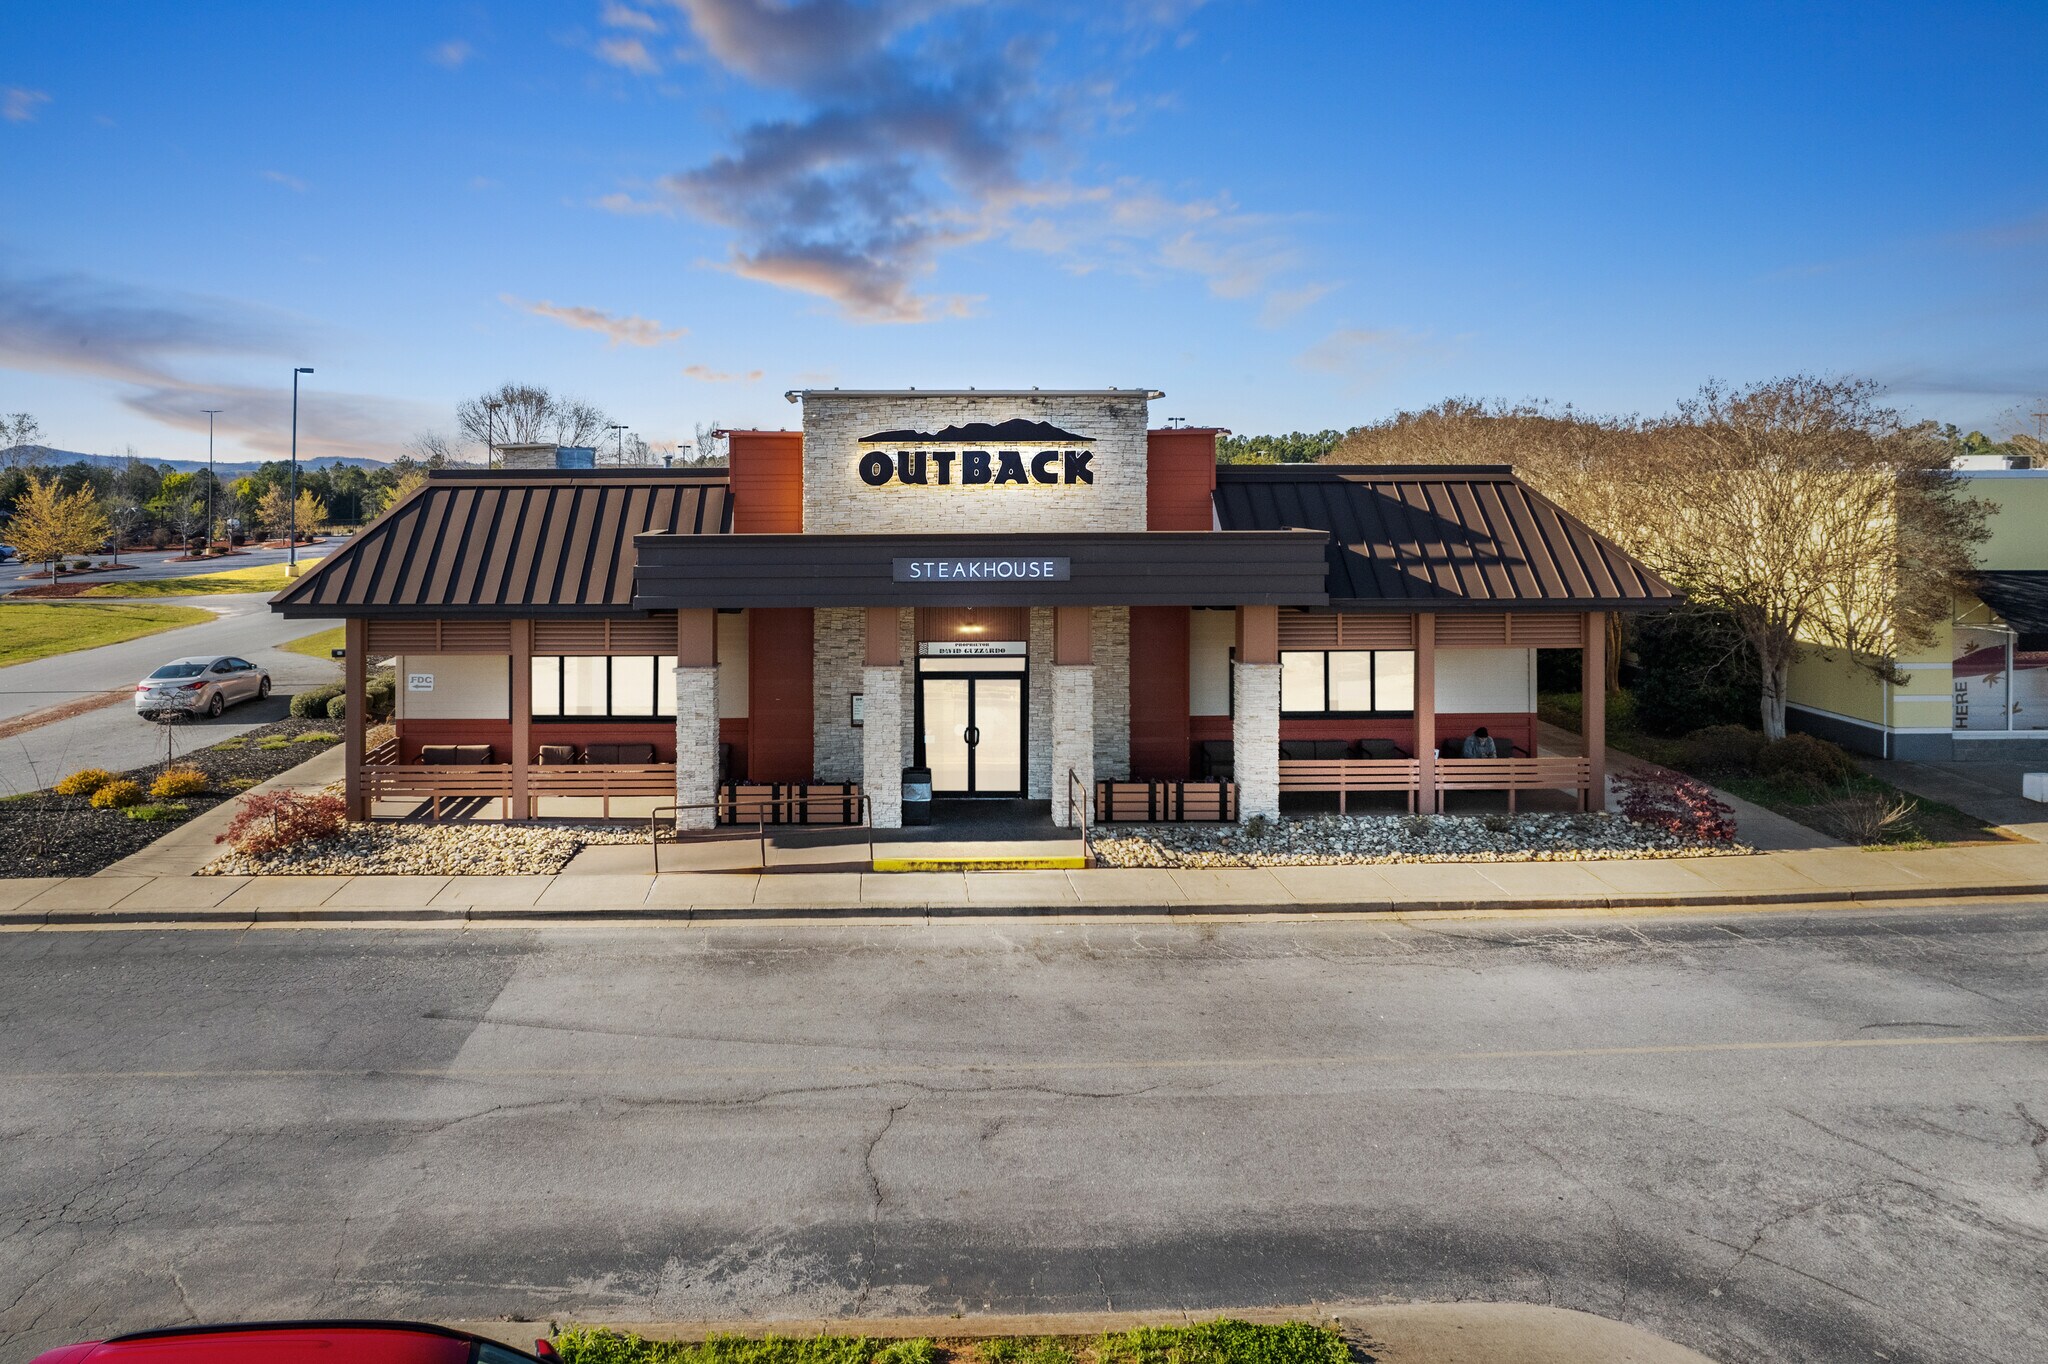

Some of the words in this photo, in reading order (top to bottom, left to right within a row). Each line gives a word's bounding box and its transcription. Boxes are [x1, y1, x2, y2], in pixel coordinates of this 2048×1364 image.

[858, 450, 1095, 486] OUTBACK
[909, 561, 1054, 578] STEAKHOUSE
[410, 676, 432, 684] FDC
[1955, 682, 1968, 728] HERE
